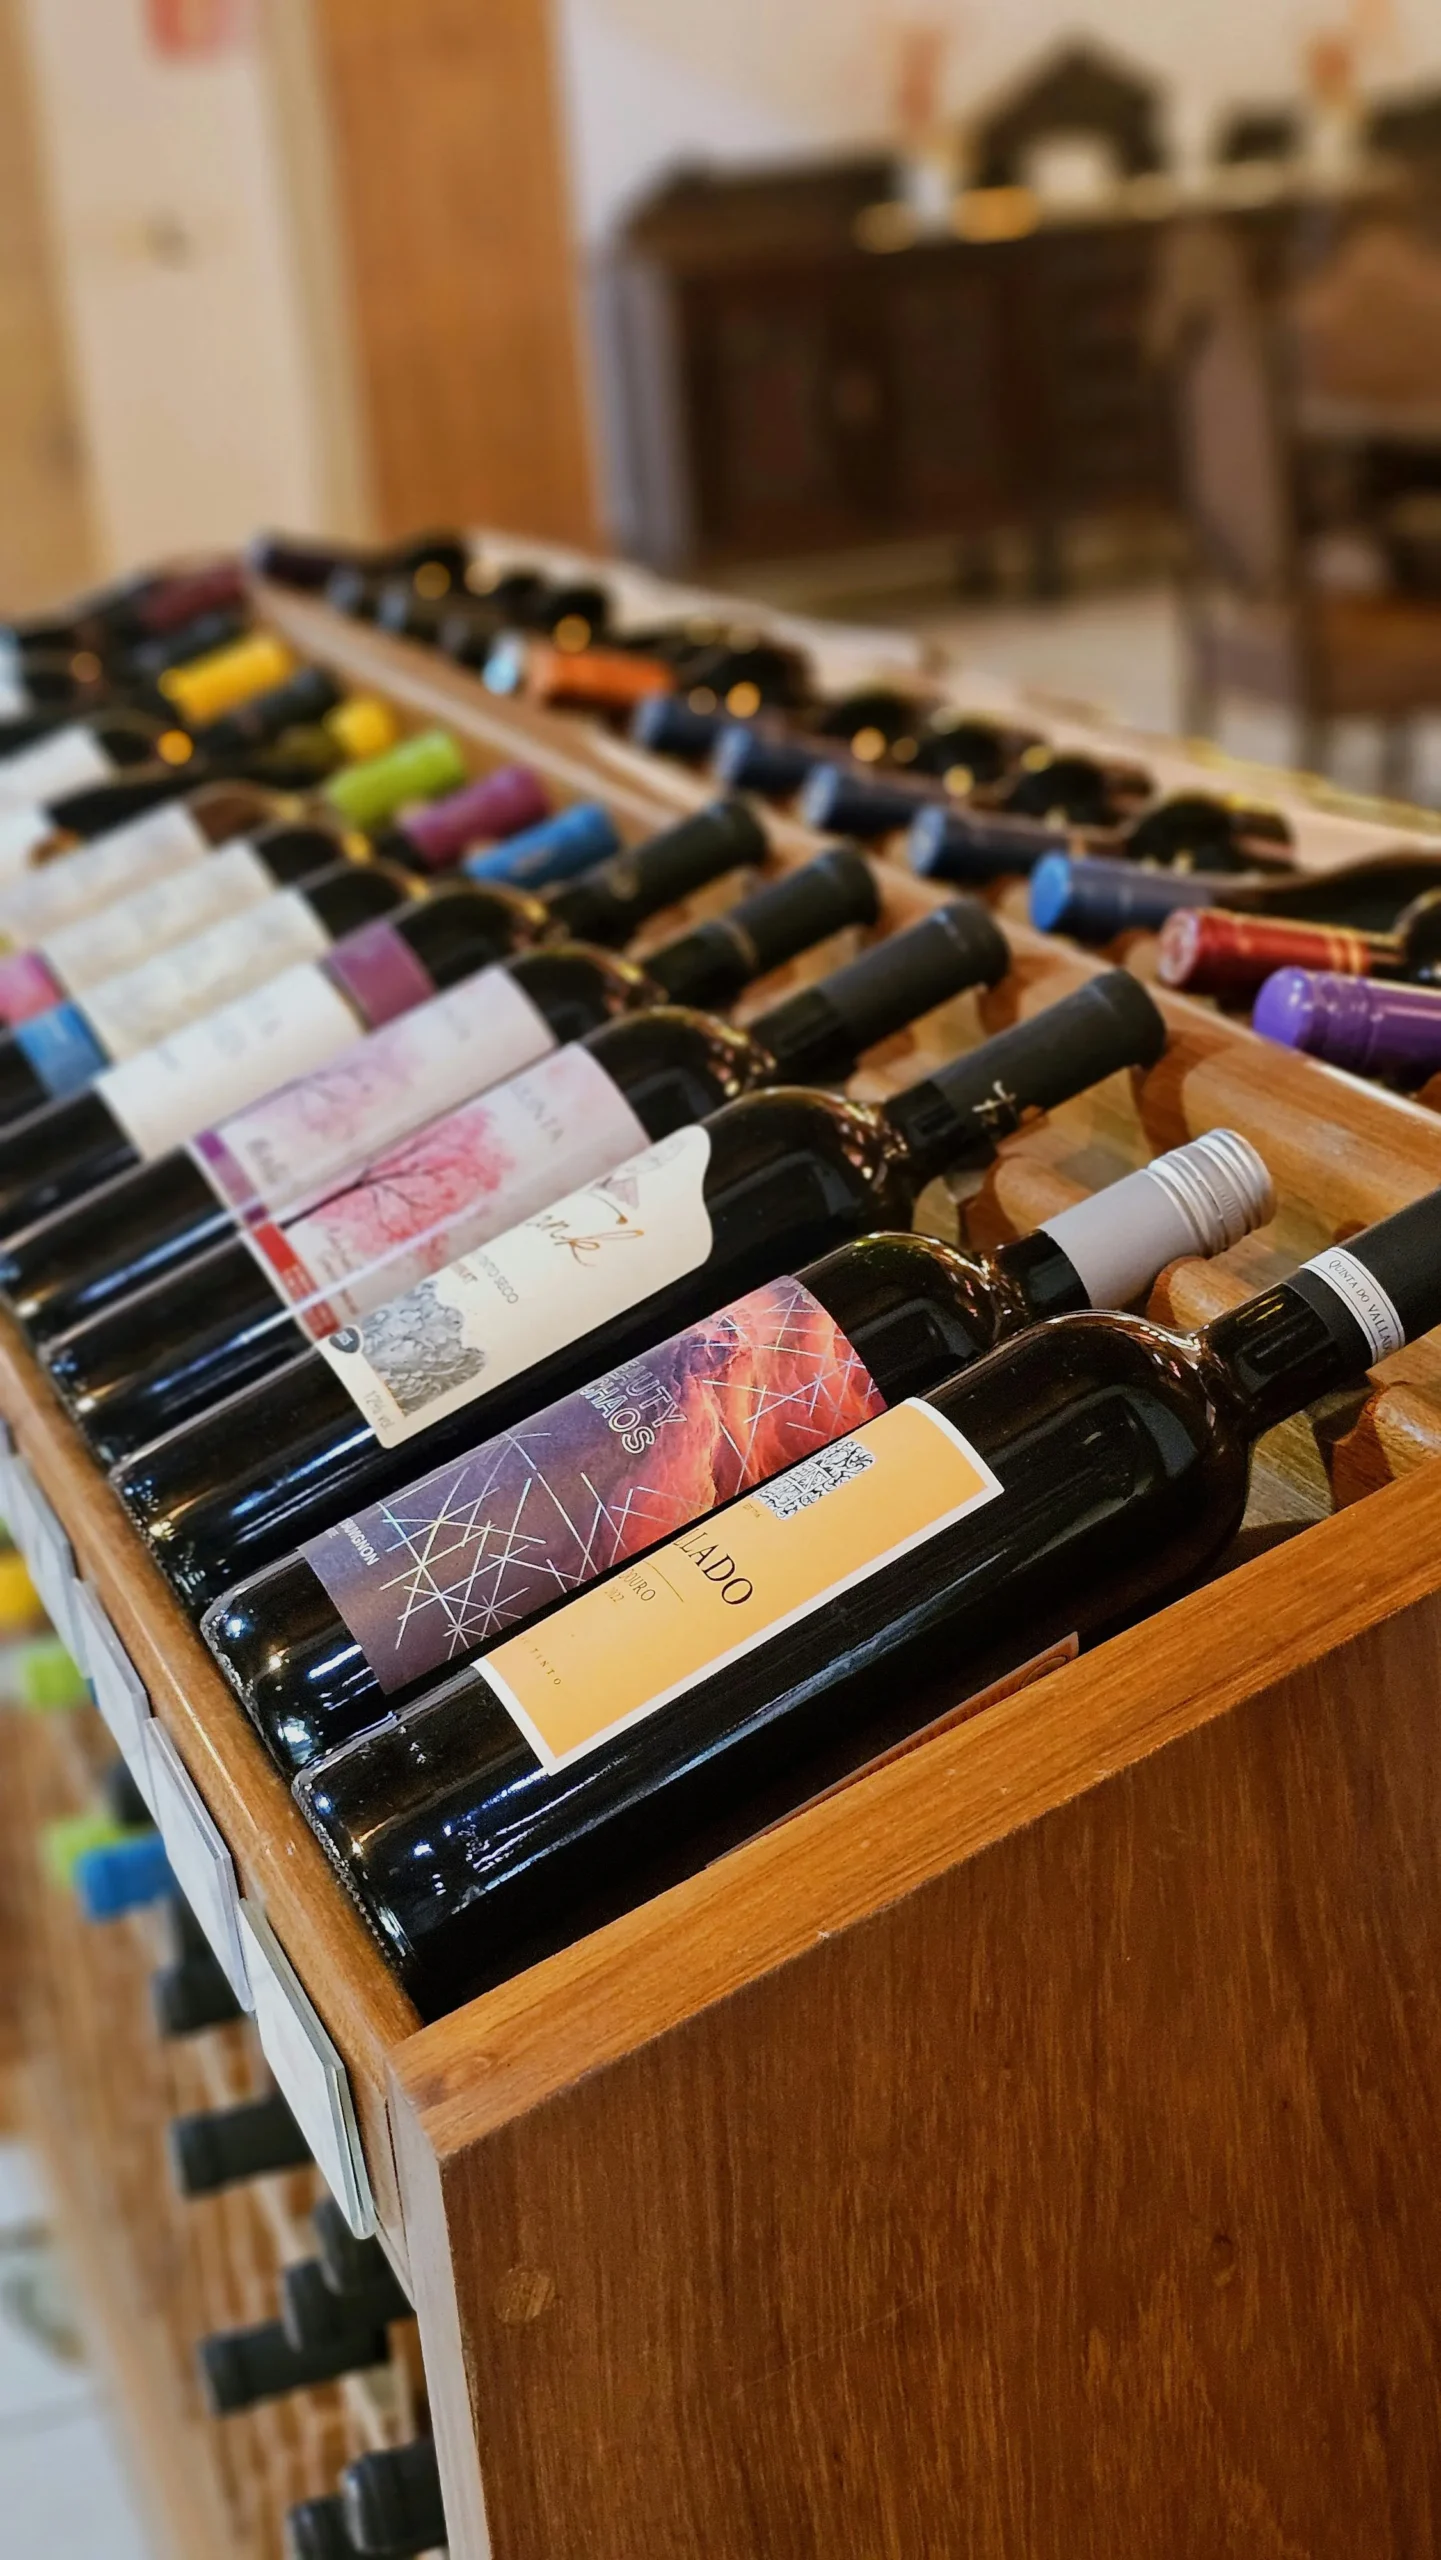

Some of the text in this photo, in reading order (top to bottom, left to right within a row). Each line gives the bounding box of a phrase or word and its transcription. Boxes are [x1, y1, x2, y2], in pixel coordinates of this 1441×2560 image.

[494, 1275, 519, 1304] SECO
[1328, 1259, 1395, 1352] QUINTA DO VALLAD
[529, 1647, 562, 1685] TINTO
